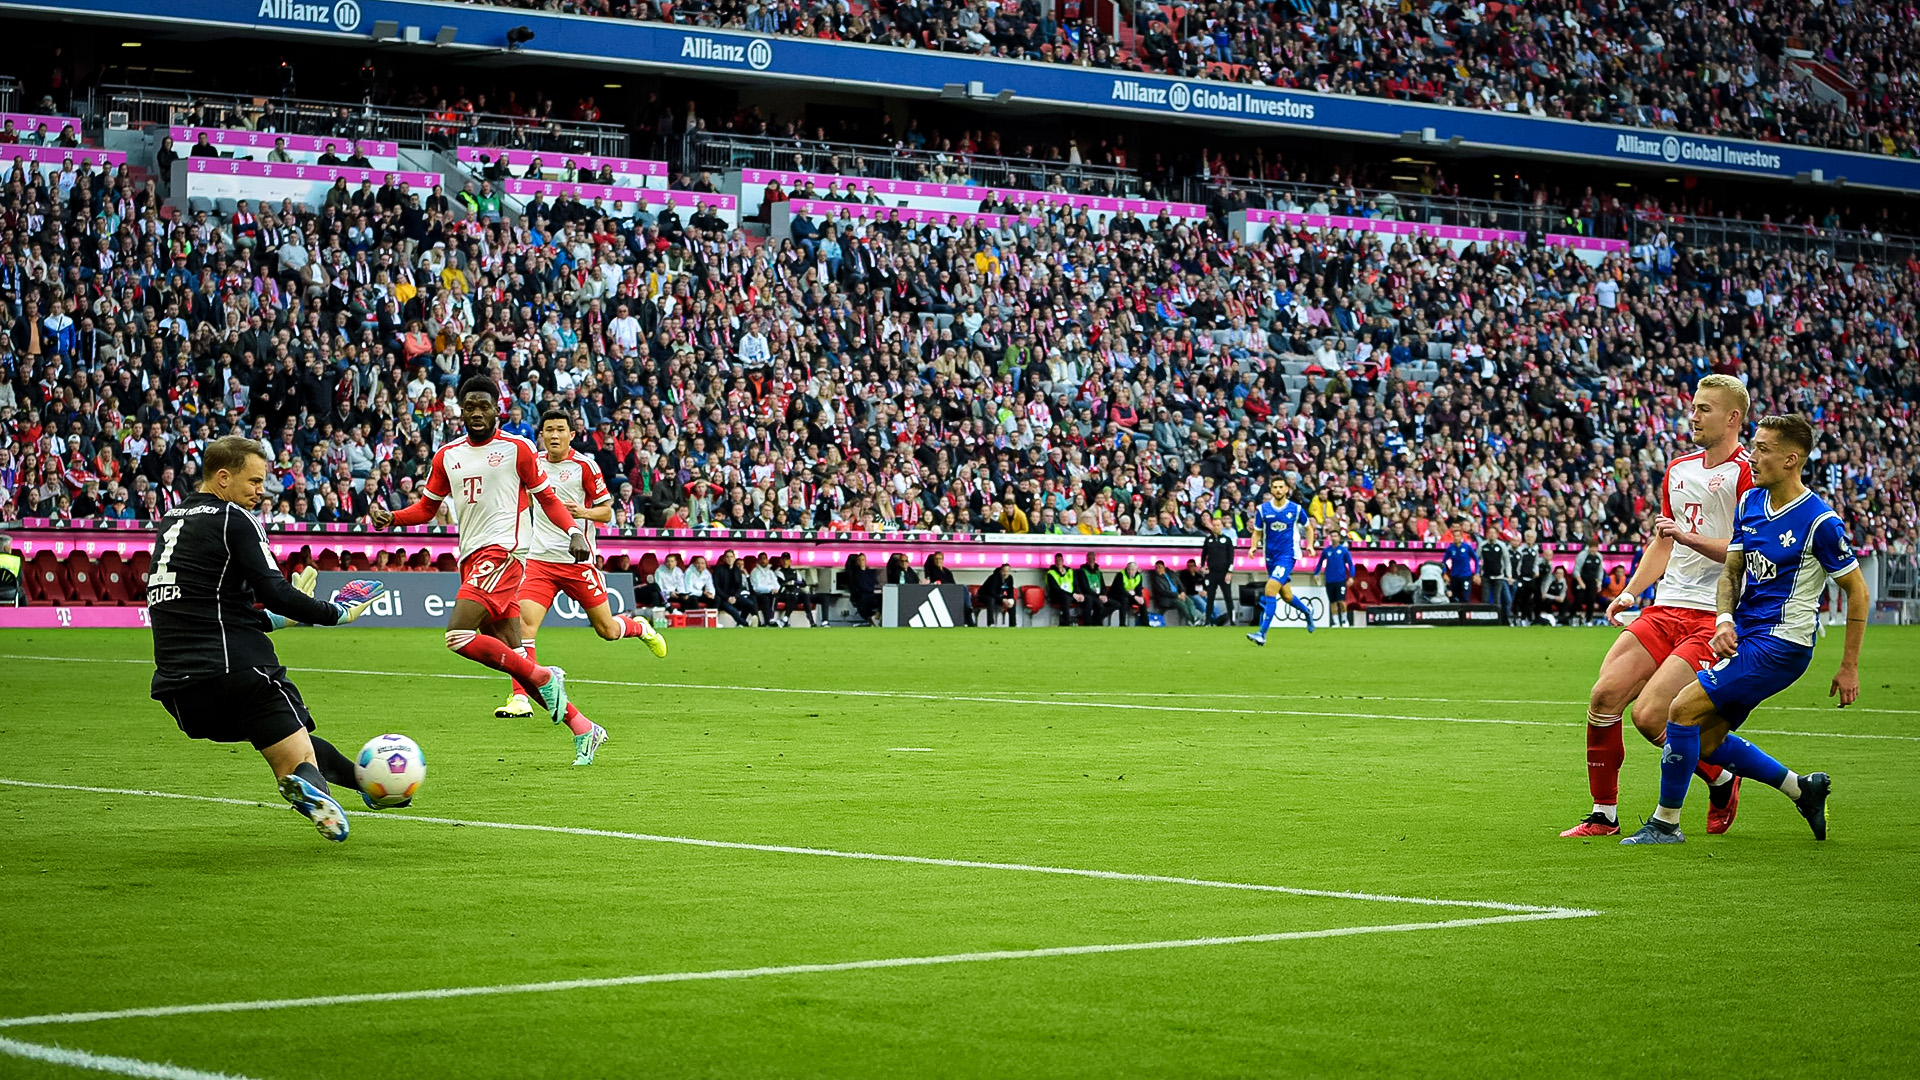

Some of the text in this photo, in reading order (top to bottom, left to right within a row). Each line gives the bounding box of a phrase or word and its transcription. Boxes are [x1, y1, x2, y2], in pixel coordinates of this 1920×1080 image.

[259, 0, 329, 22] Allianz
[682, 37, 744, 61] Allianz
[1112, 80, 1314, 119] Allianz Global Investors
[1617, 135, 1780, 169] Allianz Global Investors
[463, 476, 483, 504] T
[1684, 503, 1703, 534] T
[148, 518, 184, 587] 1
[581, 569, 598, 590] 3
[56, 608, 72, 626] T
